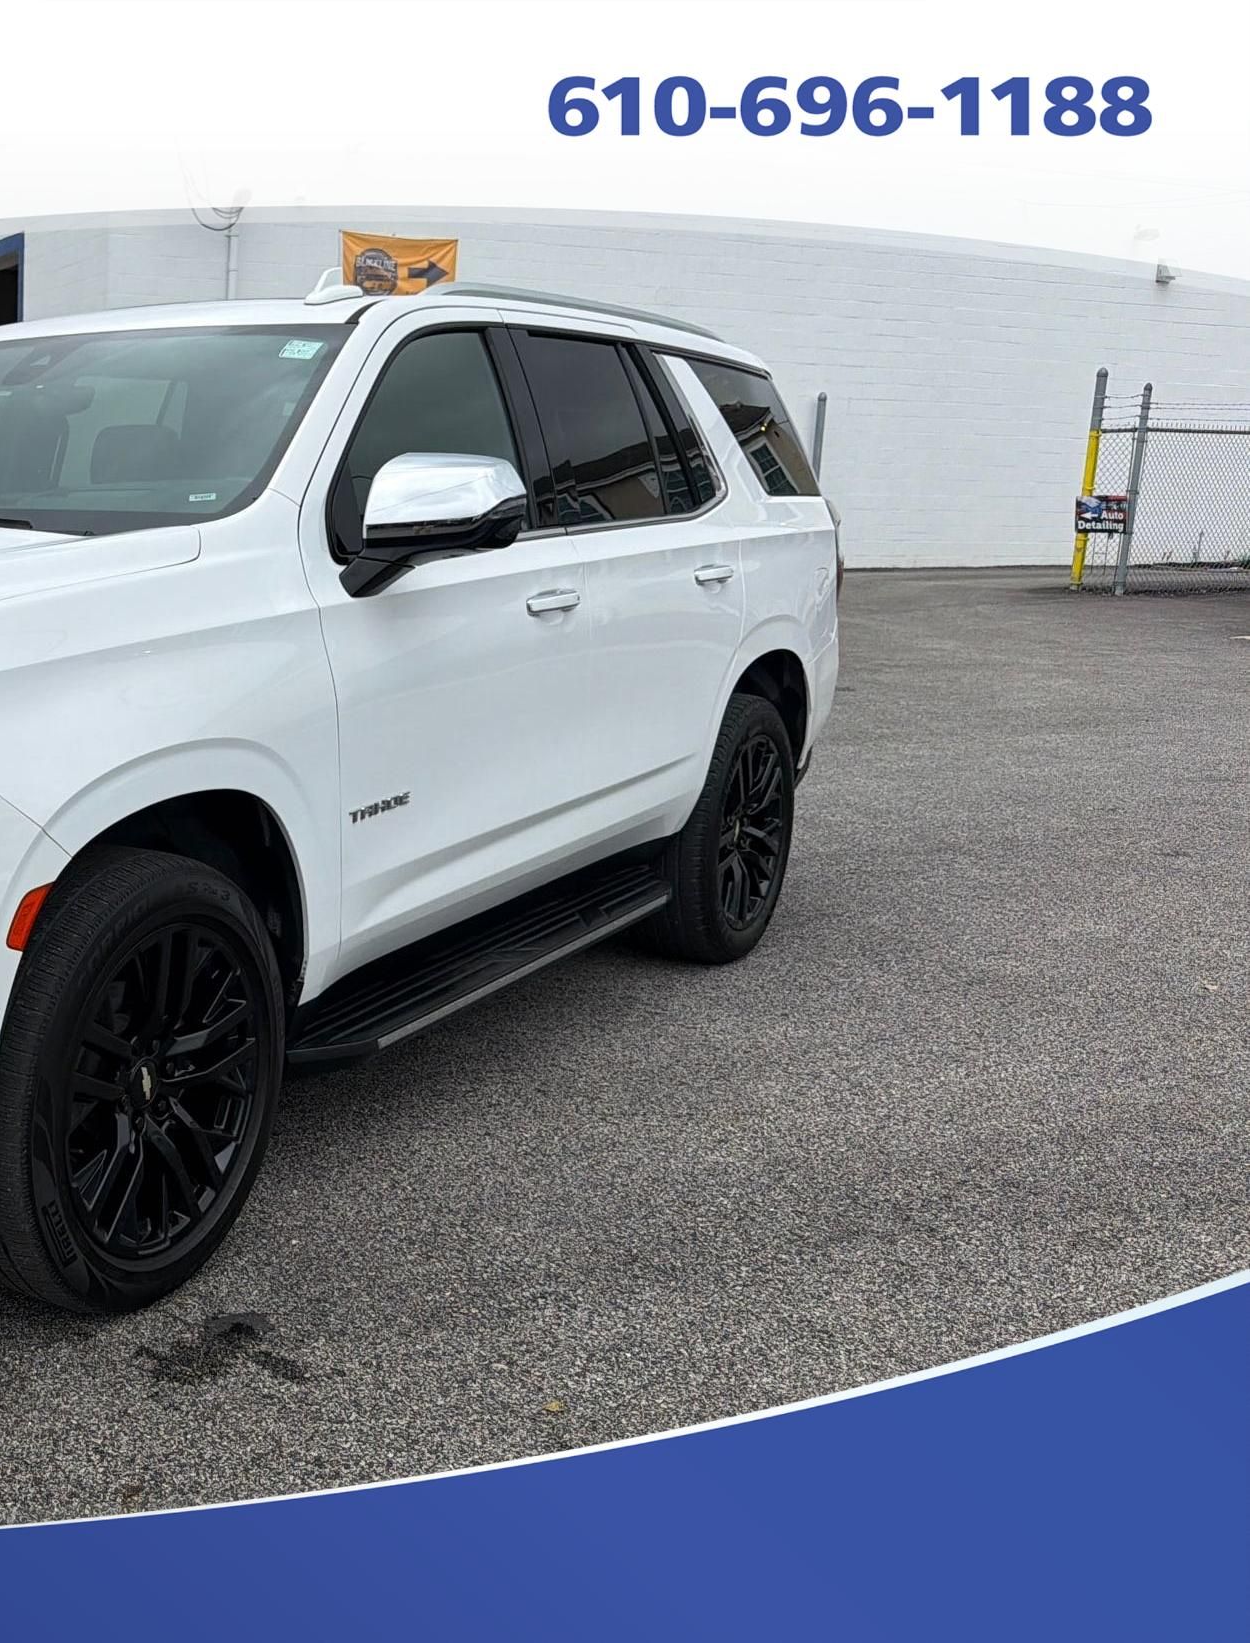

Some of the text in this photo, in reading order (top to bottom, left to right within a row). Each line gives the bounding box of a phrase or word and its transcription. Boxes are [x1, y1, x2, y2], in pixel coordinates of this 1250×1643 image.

[1101, 510, 1124, 520] Auto
[1077, 520, 1124, 532] Detailing
[348, 791, 411, 824] TAHOE
